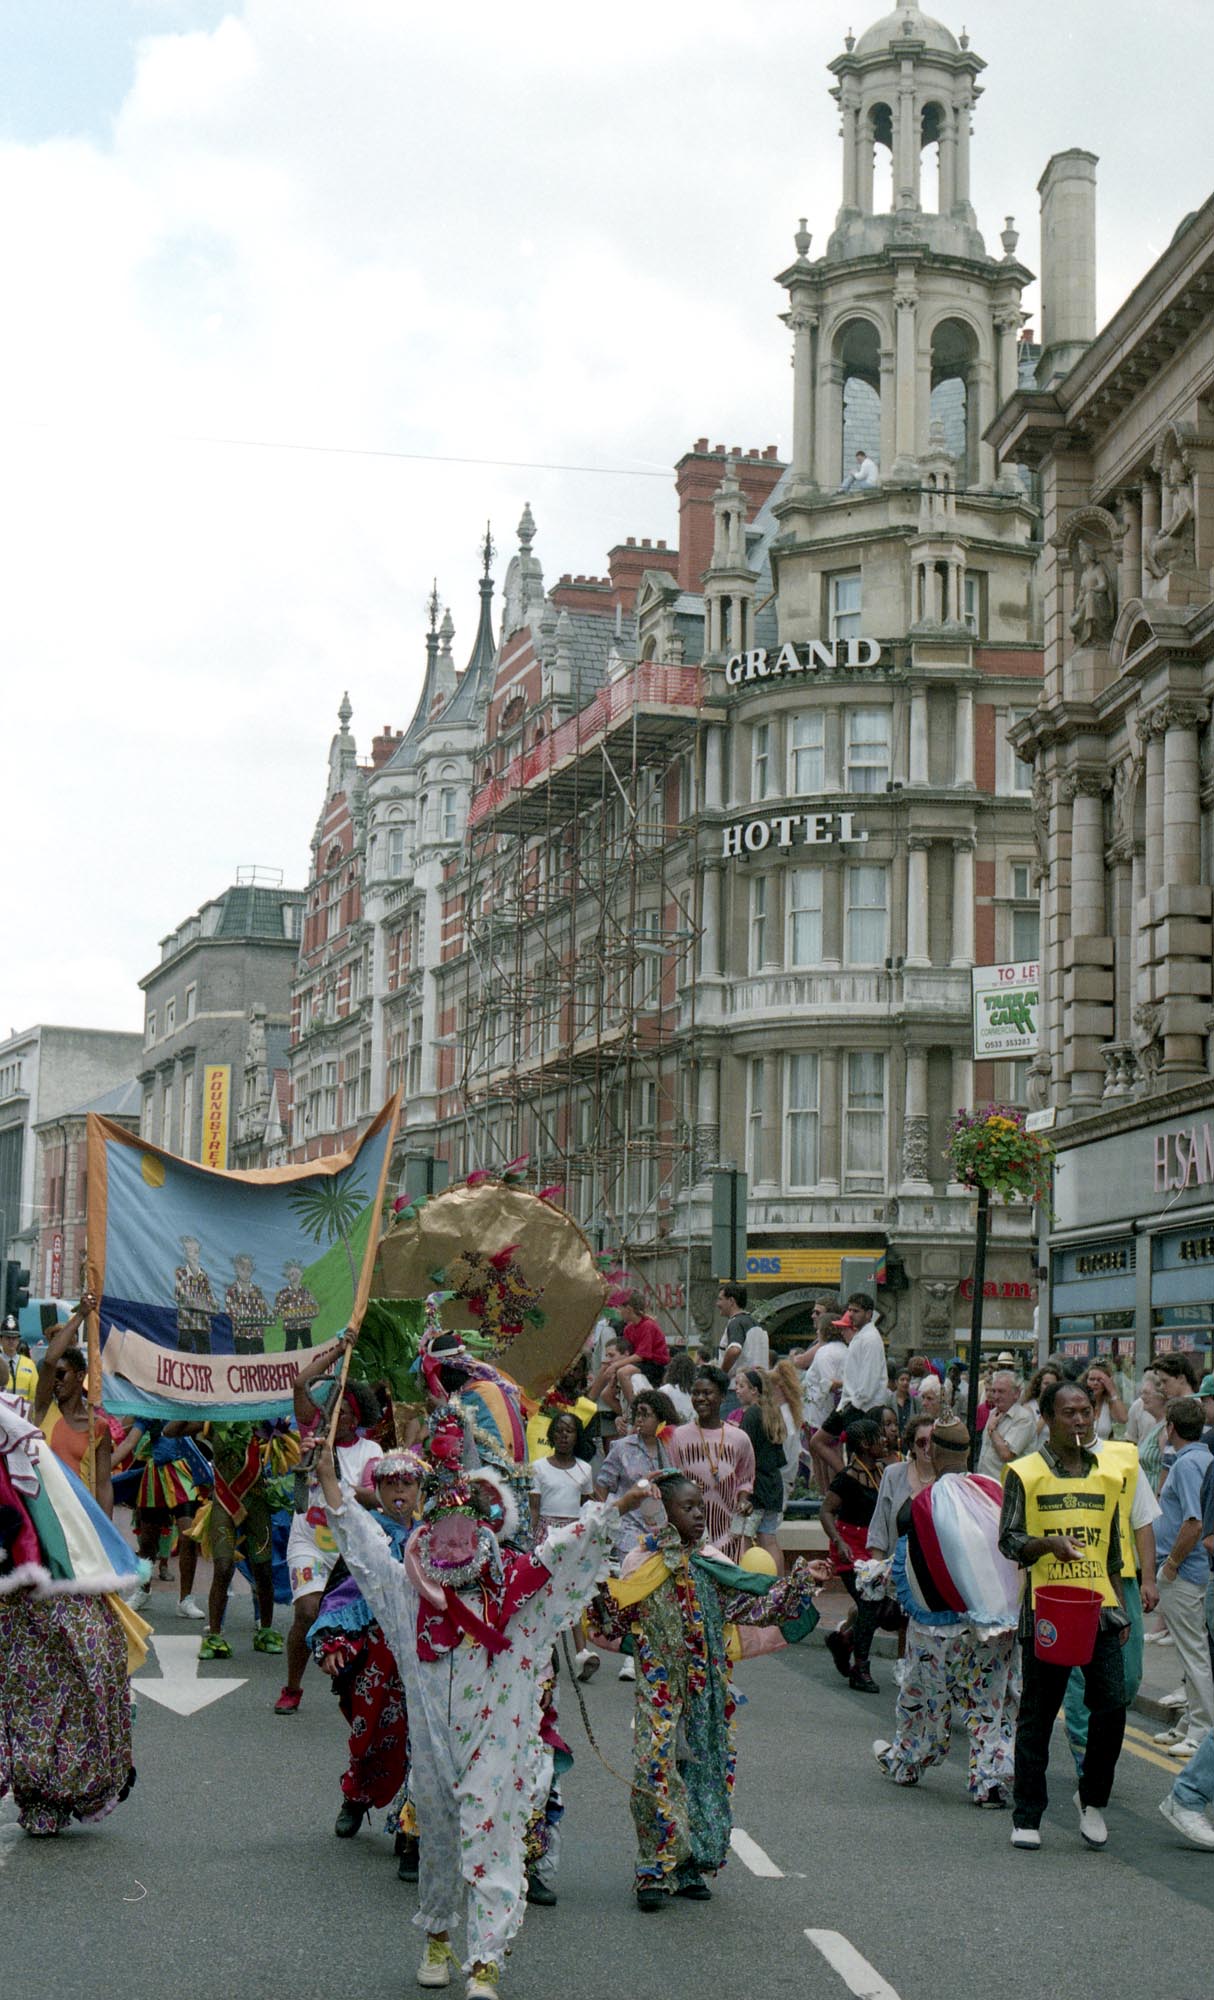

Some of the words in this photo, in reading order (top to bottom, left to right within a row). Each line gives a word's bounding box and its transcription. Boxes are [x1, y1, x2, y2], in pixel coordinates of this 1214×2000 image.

[725, 637, 882, 686] GRAND
[722, 812, 869, 858] HOTEL
[998, 967, 1015, 981] TO
[1022, 965, 1040, 978] LET
[156, 1354, 215, 1393] LEICESTER
[227, 1360, 300, 1394] CARIBBEAN
